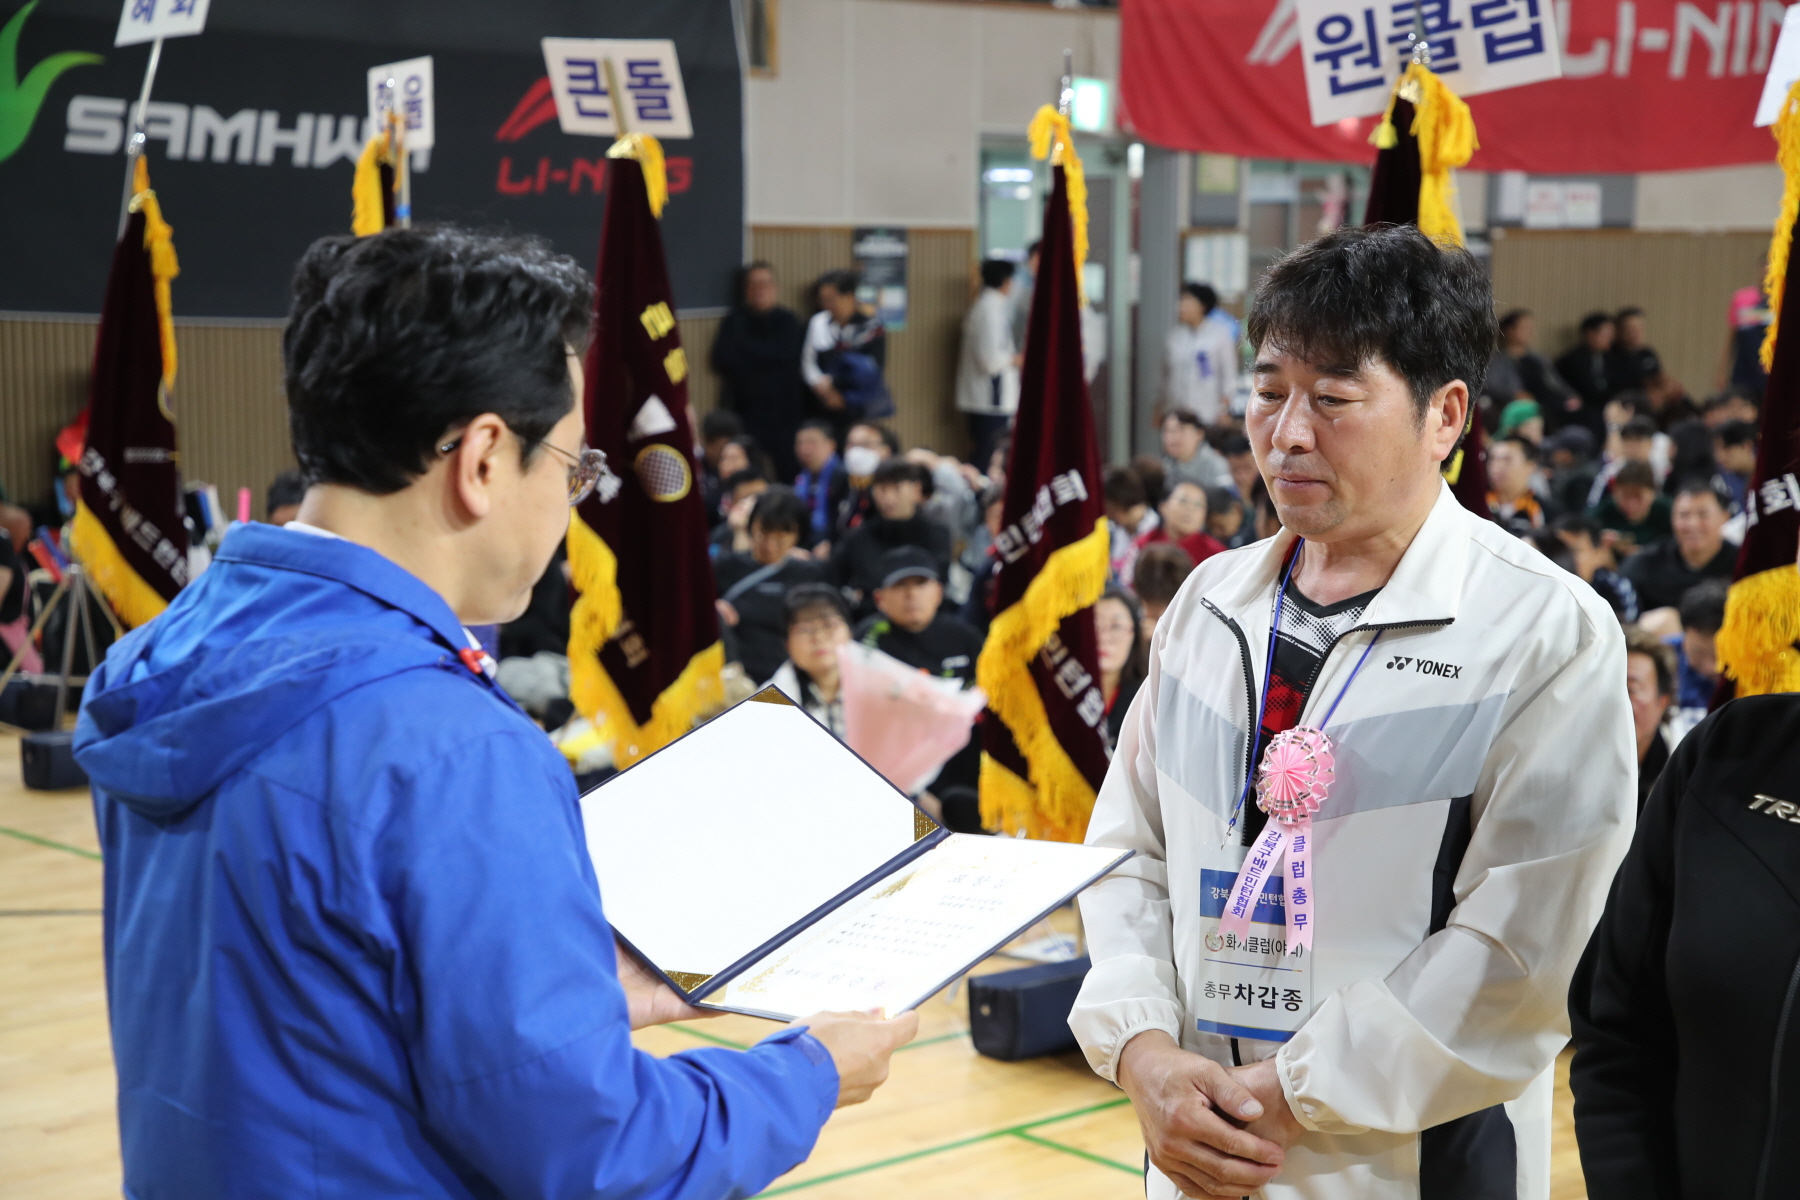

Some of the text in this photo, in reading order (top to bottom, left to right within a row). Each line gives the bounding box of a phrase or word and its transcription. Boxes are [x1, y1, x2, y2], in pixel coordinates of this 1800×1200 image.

[1313, 0, 1545, 96] 원클럽
[64, 94, 432, 173] SAMHW
[496, 157, 694, 195] LI-NG
[1415, 658, 1463, 679] YONEX
[1747, 793, 1800, 824] TR
[1233, 983, 1304, 1012] 차갑종
